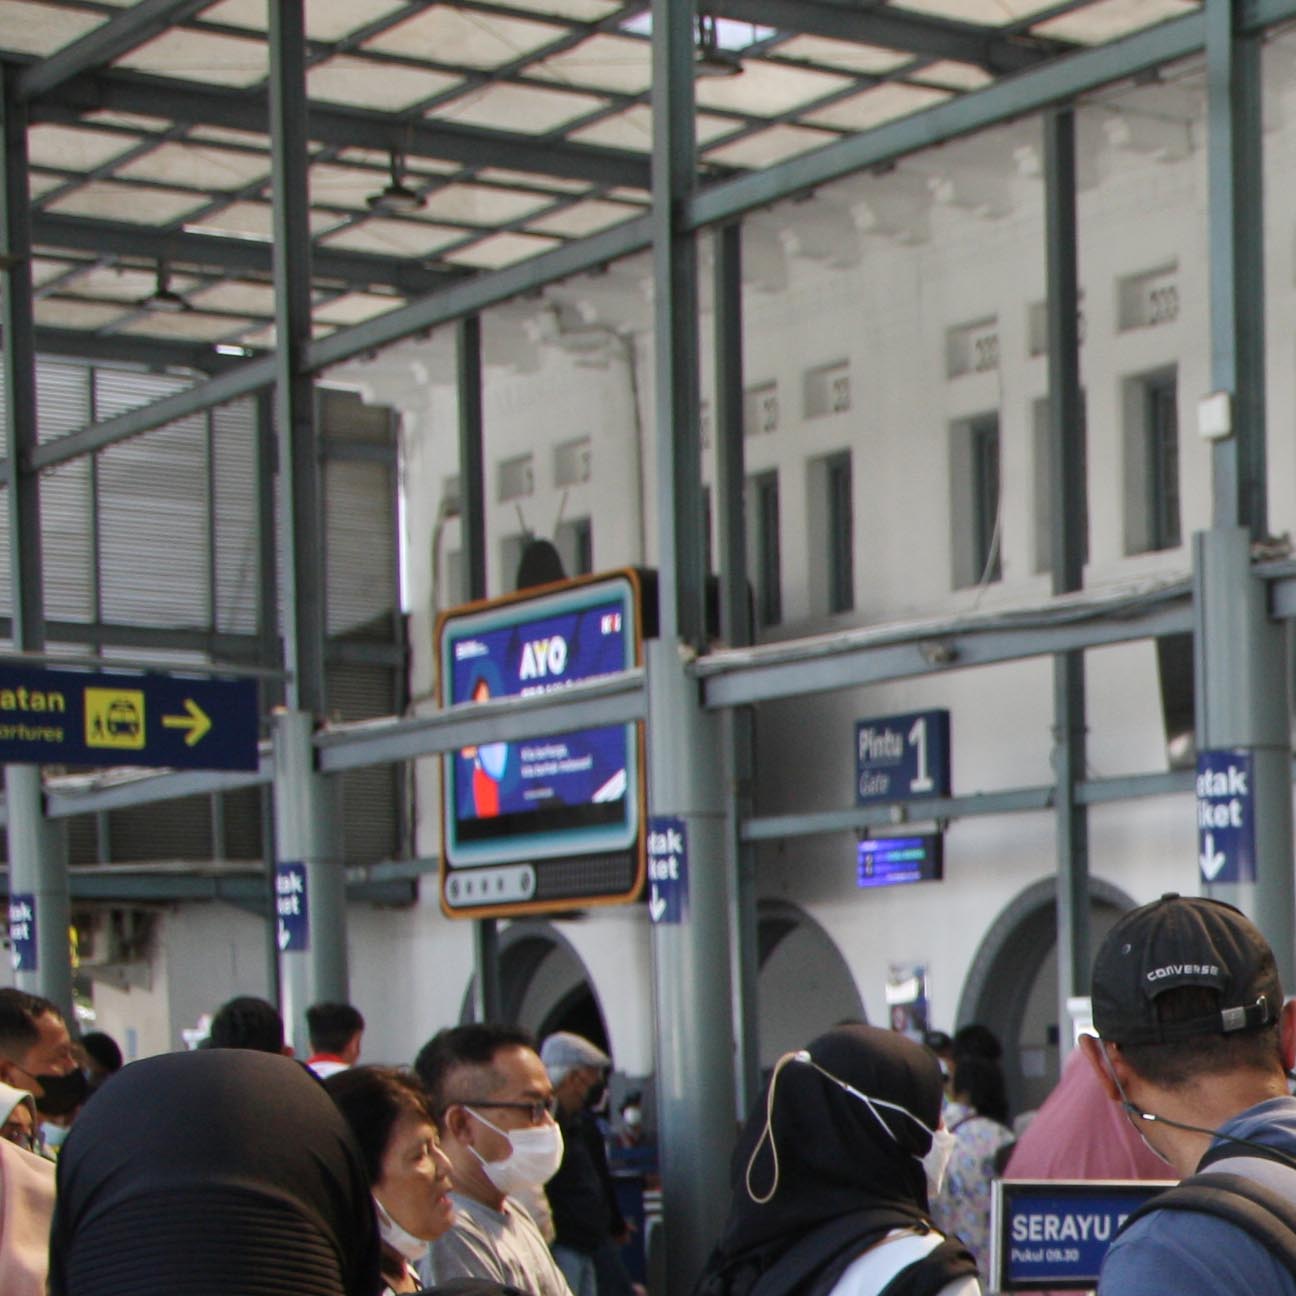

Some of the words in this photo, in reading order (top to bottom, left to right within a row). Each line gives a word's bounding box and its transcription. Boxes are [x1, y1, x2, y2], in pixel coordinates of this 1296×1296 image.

[519, 634, 568, 681] AYO
[859, 729, 904, 761] Pintu
[907, 717, 935, 794] 1
[859, 771, 891, 797] Gate
[1146, 964, 1219, 982] CONVERSE
[1011, 1213, 1112, 1241] SERAYU
[1011, 1247, 1044, 1262] Pukul
